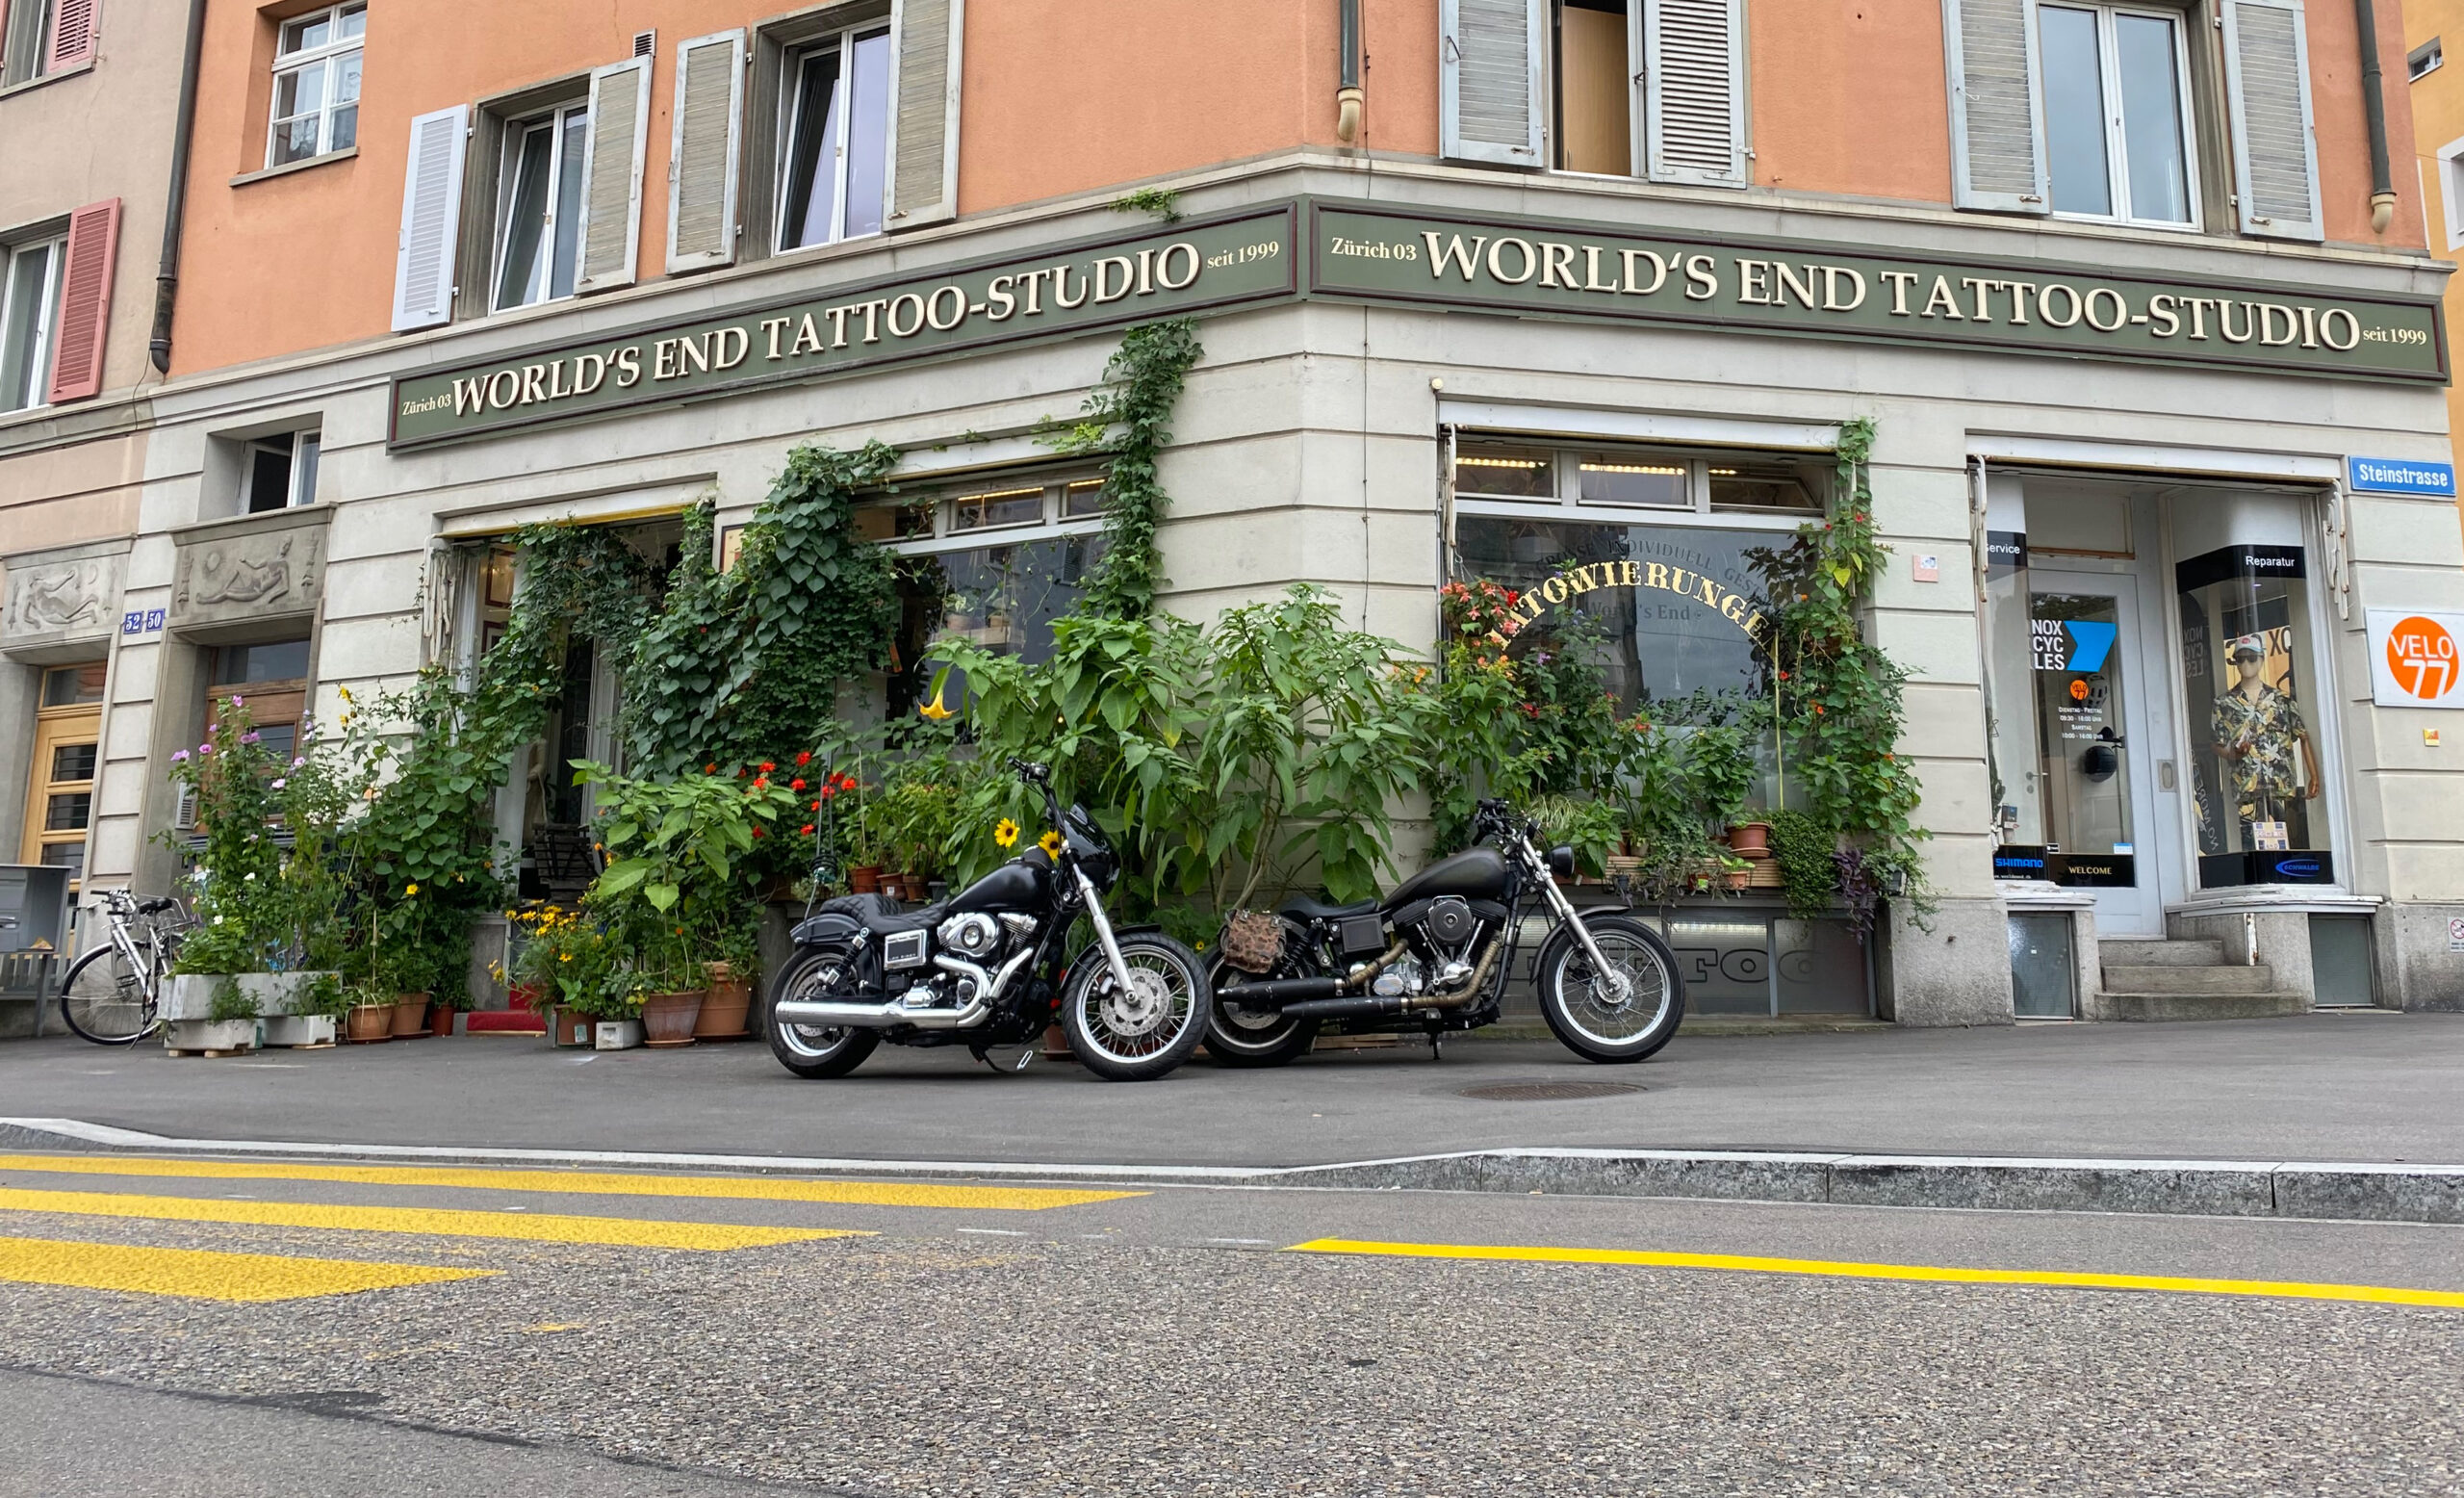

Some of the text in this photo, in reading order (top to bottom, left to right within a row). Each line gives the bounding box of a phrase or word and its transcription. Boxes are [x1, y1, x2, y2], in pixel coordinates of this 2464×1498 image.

[1331, 230, 2427, 351] Zürich 03 WORLD'S END TATTOO-STUDIO seit 1999
[402, 241, 1280, 418] Zürich 03 WORLD'S END TATTOO-STUDIO seit 1999
[2359, 463, 2449, 487] Steinstrasse
[1607, 538, 1713, 571] INDIVIDUELL
[2246, 555, 2296, 568] Reparatur
[147, 612, 161, 628] 50
[1657, 604, 1690, 621] End
[126, 614, 140, 631] 52
[2032, 619, 2064, 636] NOX
[2033, 636, 2065, 653] CYC
[2389, 633, 2454, 659] VELO
[2034, 653, 2066, 671] LES
[2402, 659, 2451, 700] 77
[2074, 689, 2087, 700] 77
[1994, 858, 2043, 868] SHIMANO
[2068, 865, 2113, 875] WELCOME
